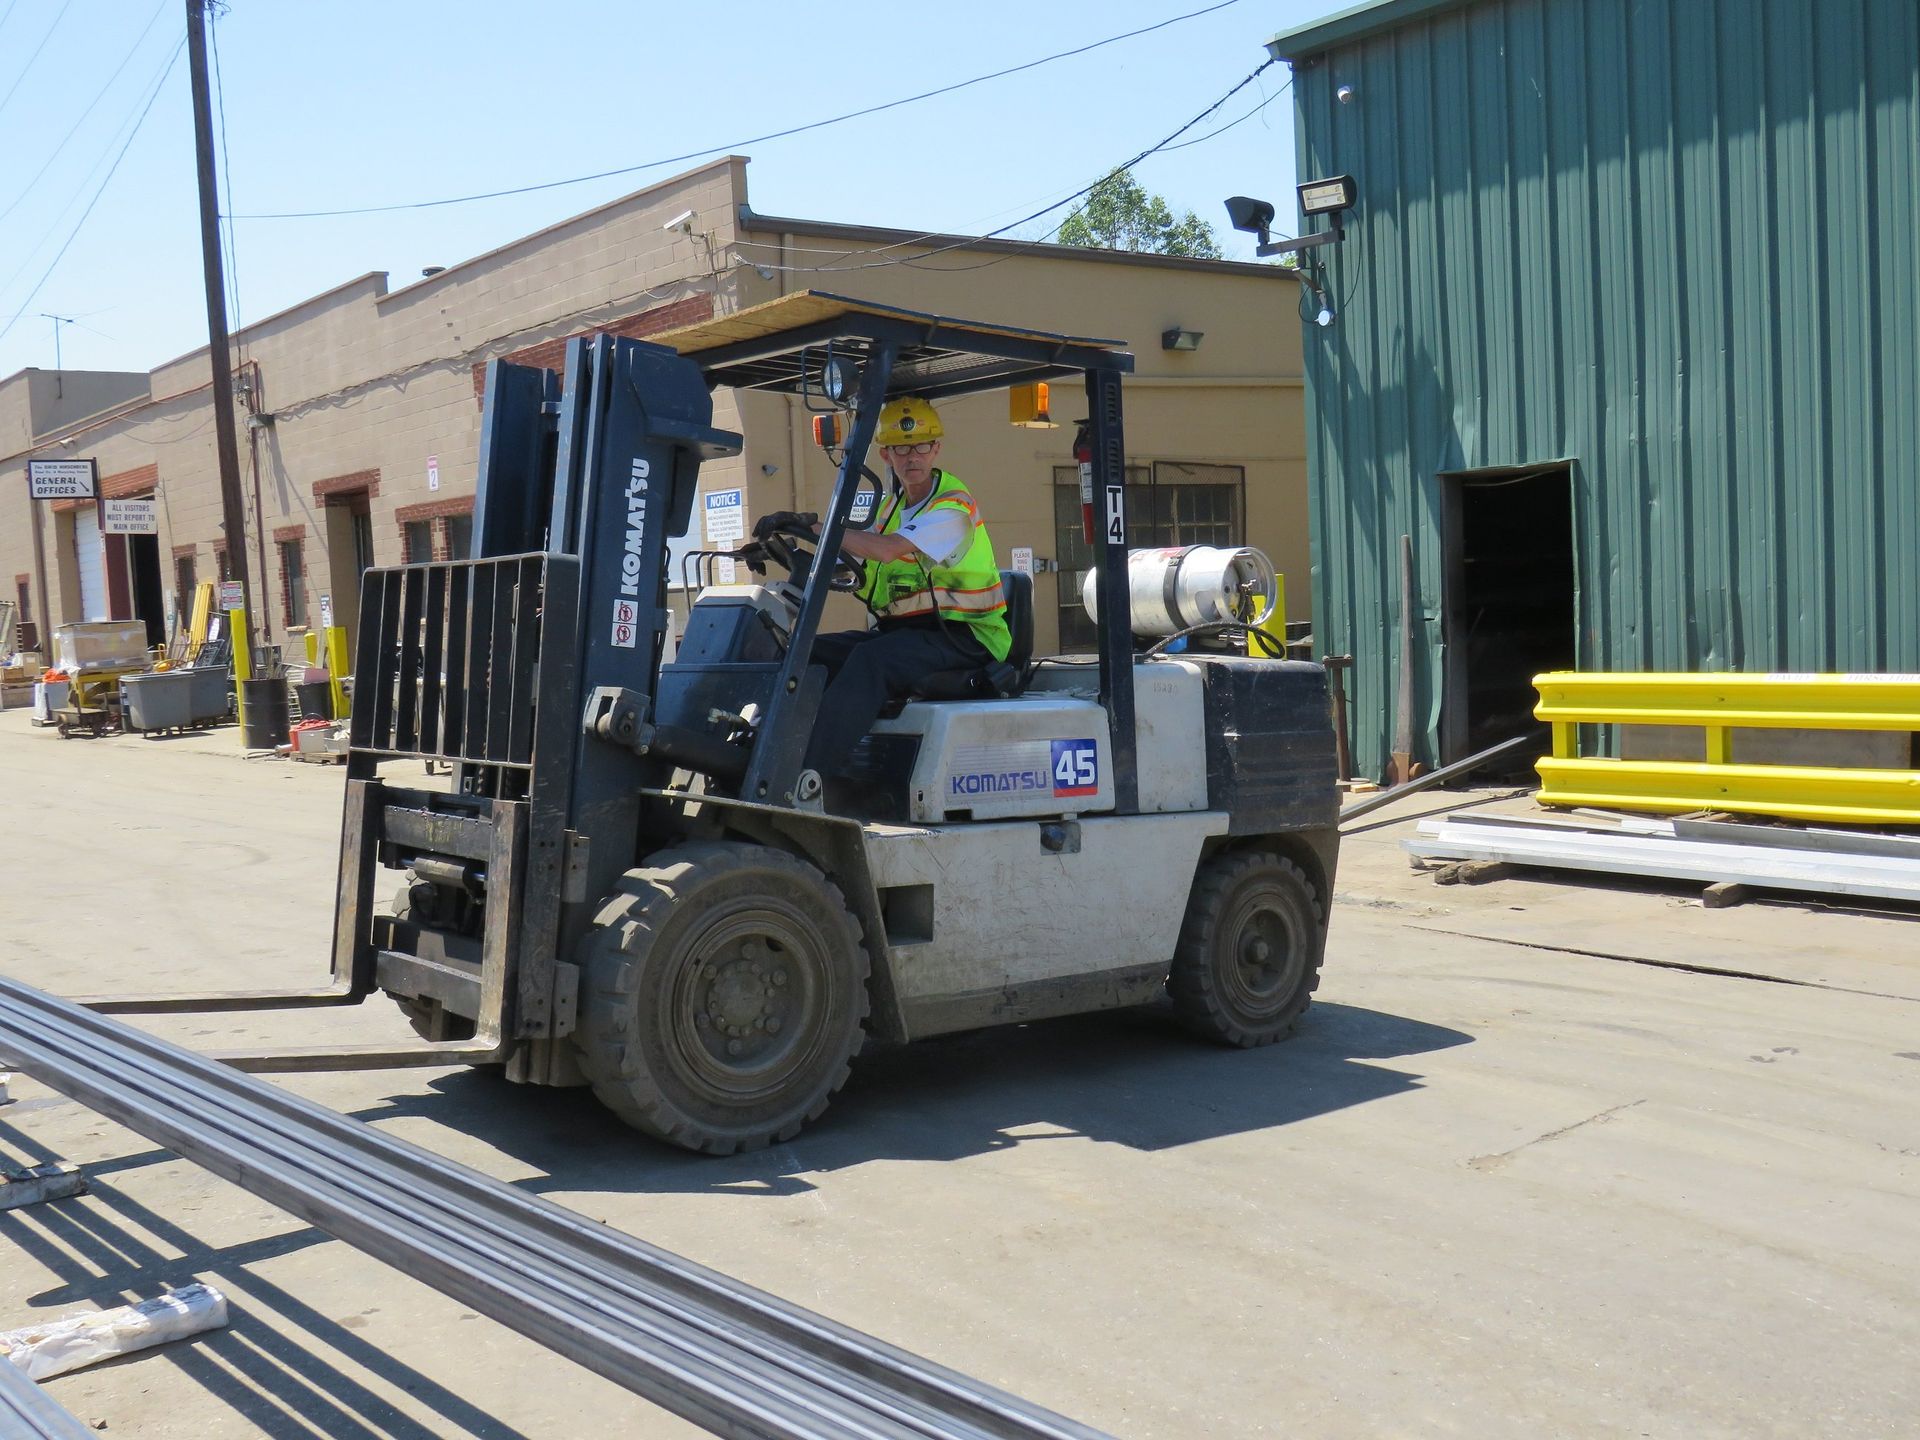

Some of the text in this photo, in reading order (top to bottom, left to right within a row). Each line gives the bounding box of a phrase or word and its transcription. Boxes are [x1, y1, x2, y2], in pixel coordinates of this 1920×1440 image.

[431, 470, 437, 487] 2
[37, 486, 76, 494] OFFICES
[124, 504, 149, 512] VISITORS
[710, 493, 736, 508] NOTICE
[107, 513, 121, 521] MUST
[620, 457, 650, 596] KOMATSU
[952, 749, 1095, 794] KOMATSU 45
